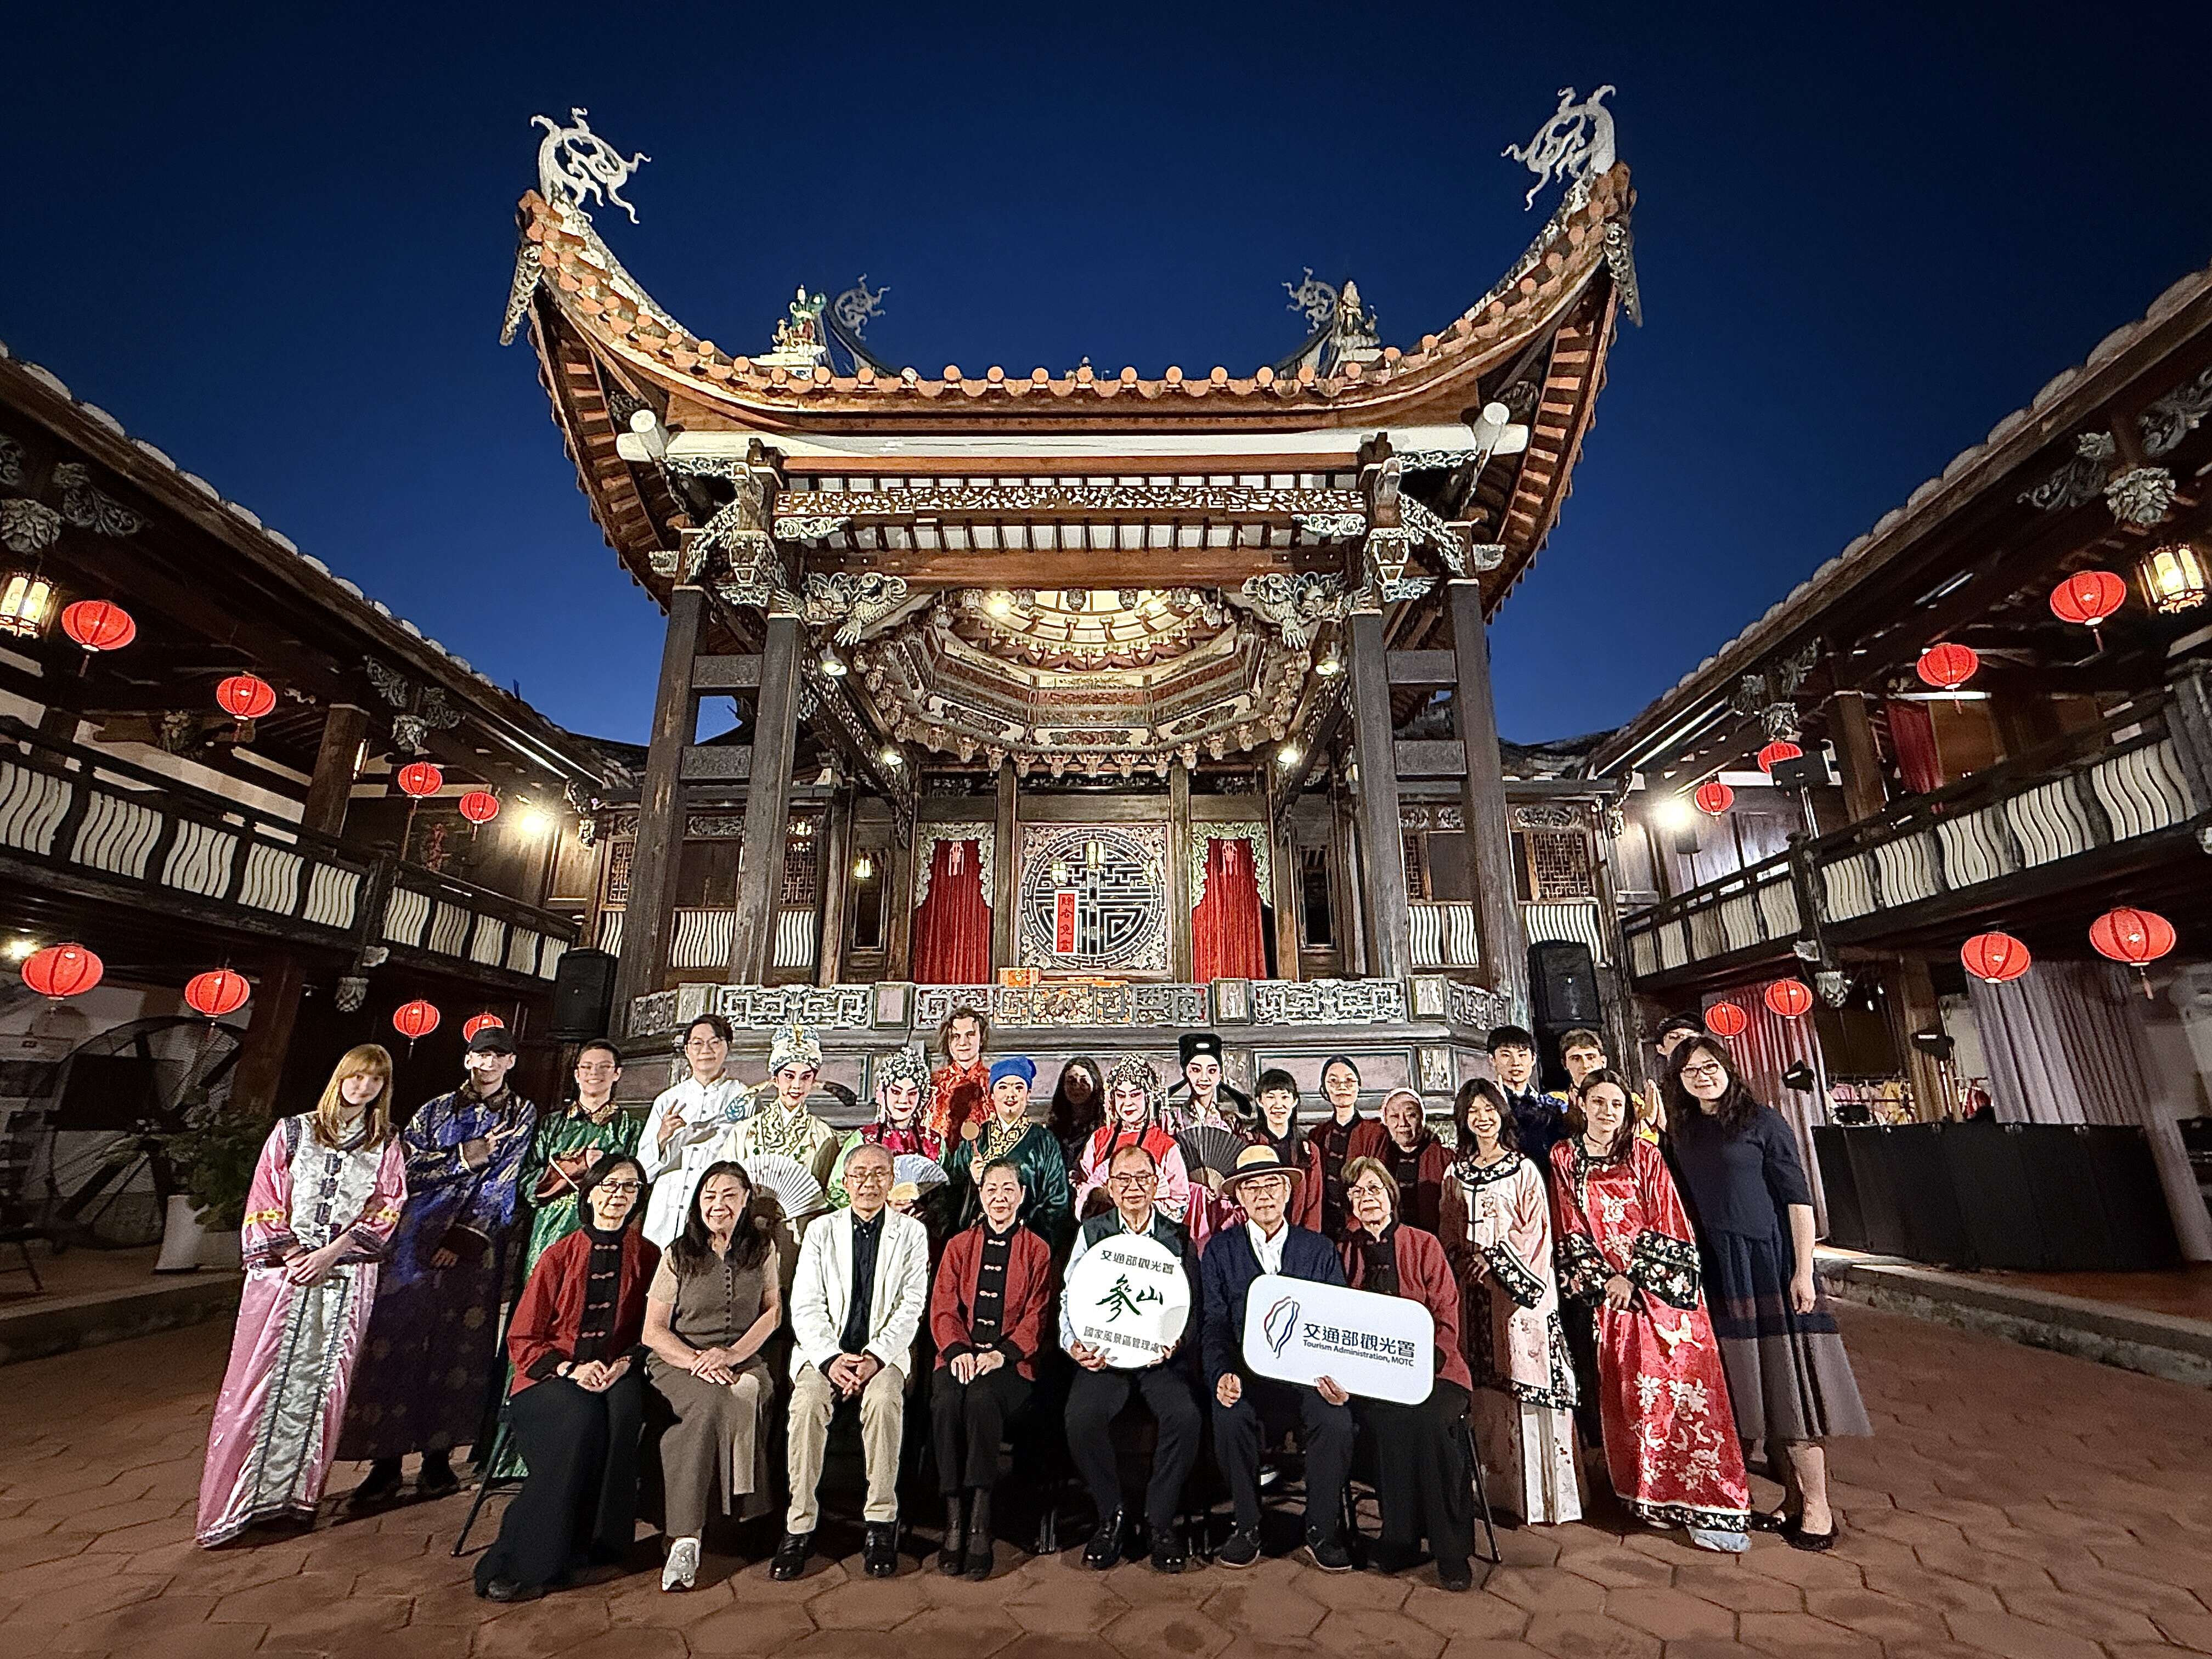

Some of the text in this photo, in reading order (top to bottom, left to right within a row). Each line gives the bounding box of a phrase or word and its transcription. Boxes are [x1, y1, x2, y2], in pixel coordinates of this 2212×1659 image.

[1101, 1250, 1174, 1274] 交通部觀光署
[1303, 1323, 1415, 1358] 交通部觀光署
[1304, 1339, 1414, 1367] Tourism Administration, MOTC
